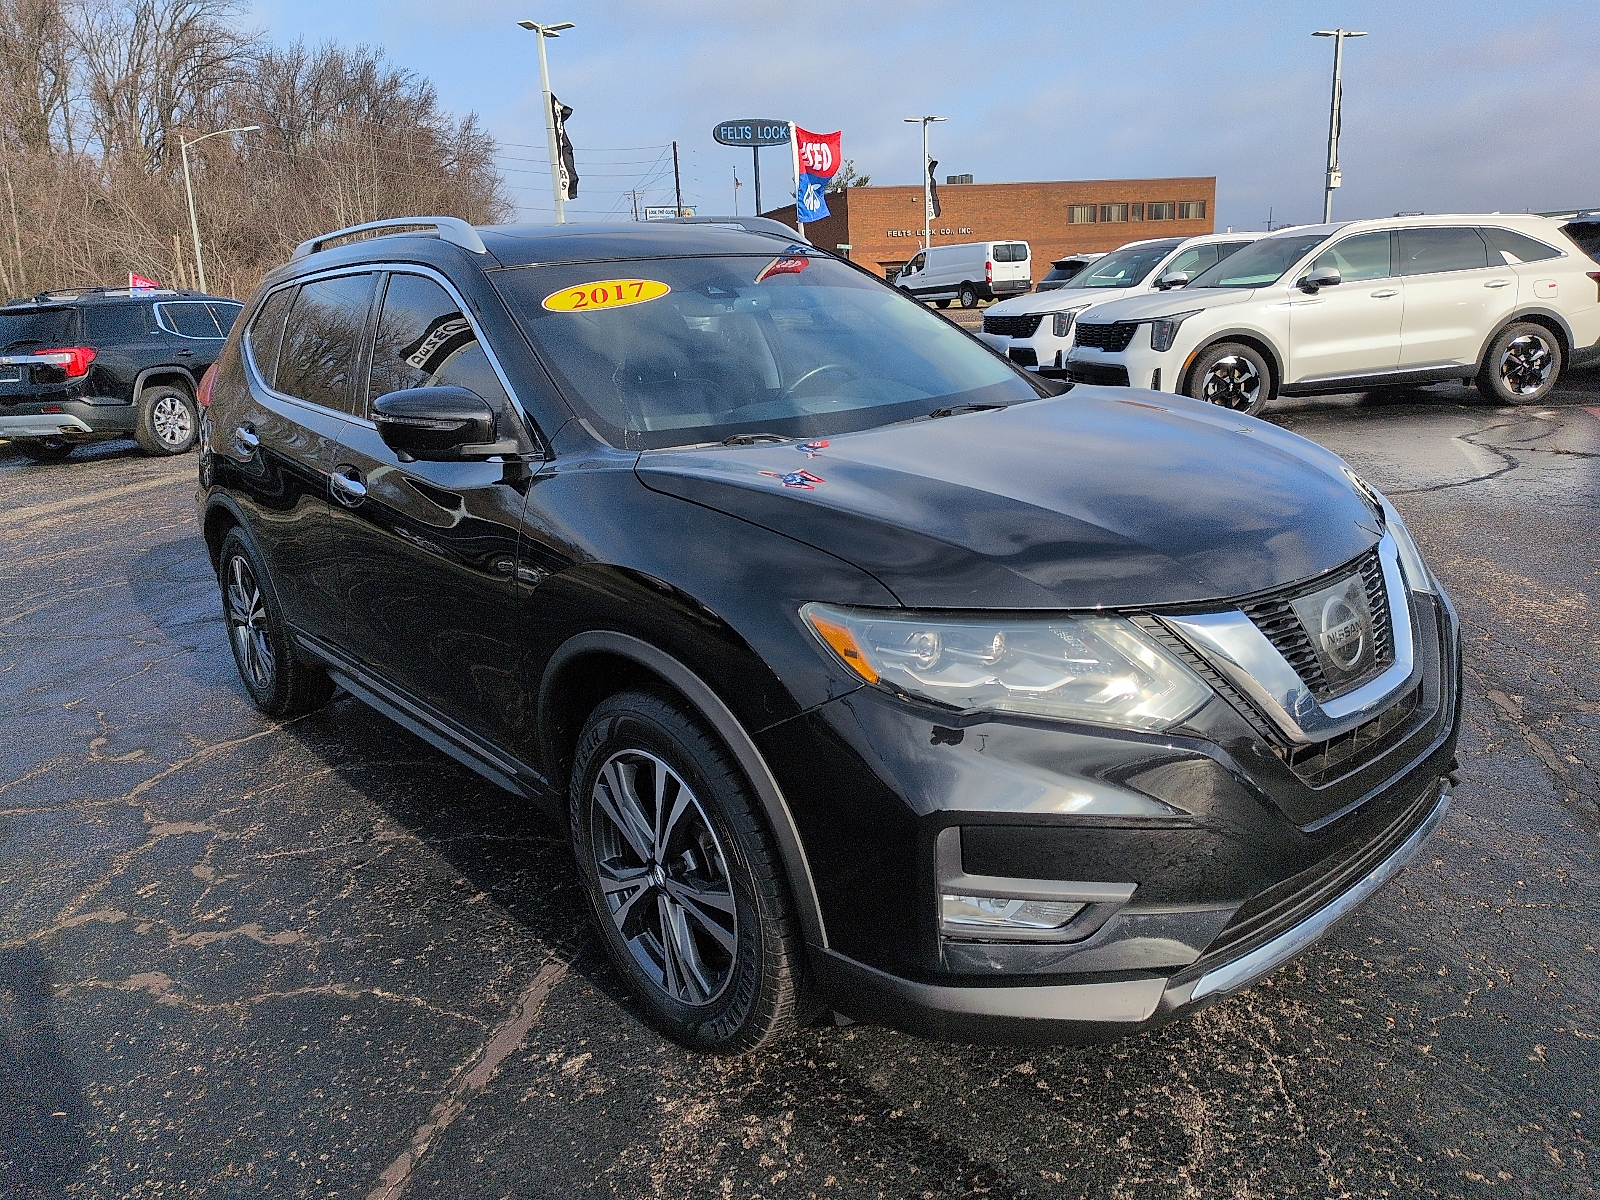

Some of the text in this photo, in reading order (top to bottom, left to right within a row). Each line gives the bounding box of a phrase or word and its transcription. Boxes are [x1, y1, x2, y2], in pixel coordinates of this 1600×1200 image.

[720, 126, 788, 140] FELTS LOCK
[887, 230, 912, 238] FELTS
[958, 227, 974, 235] INC.
[569, 282, 644, 309] 2017
[1326, 620, 1363, 646] NISSAN
